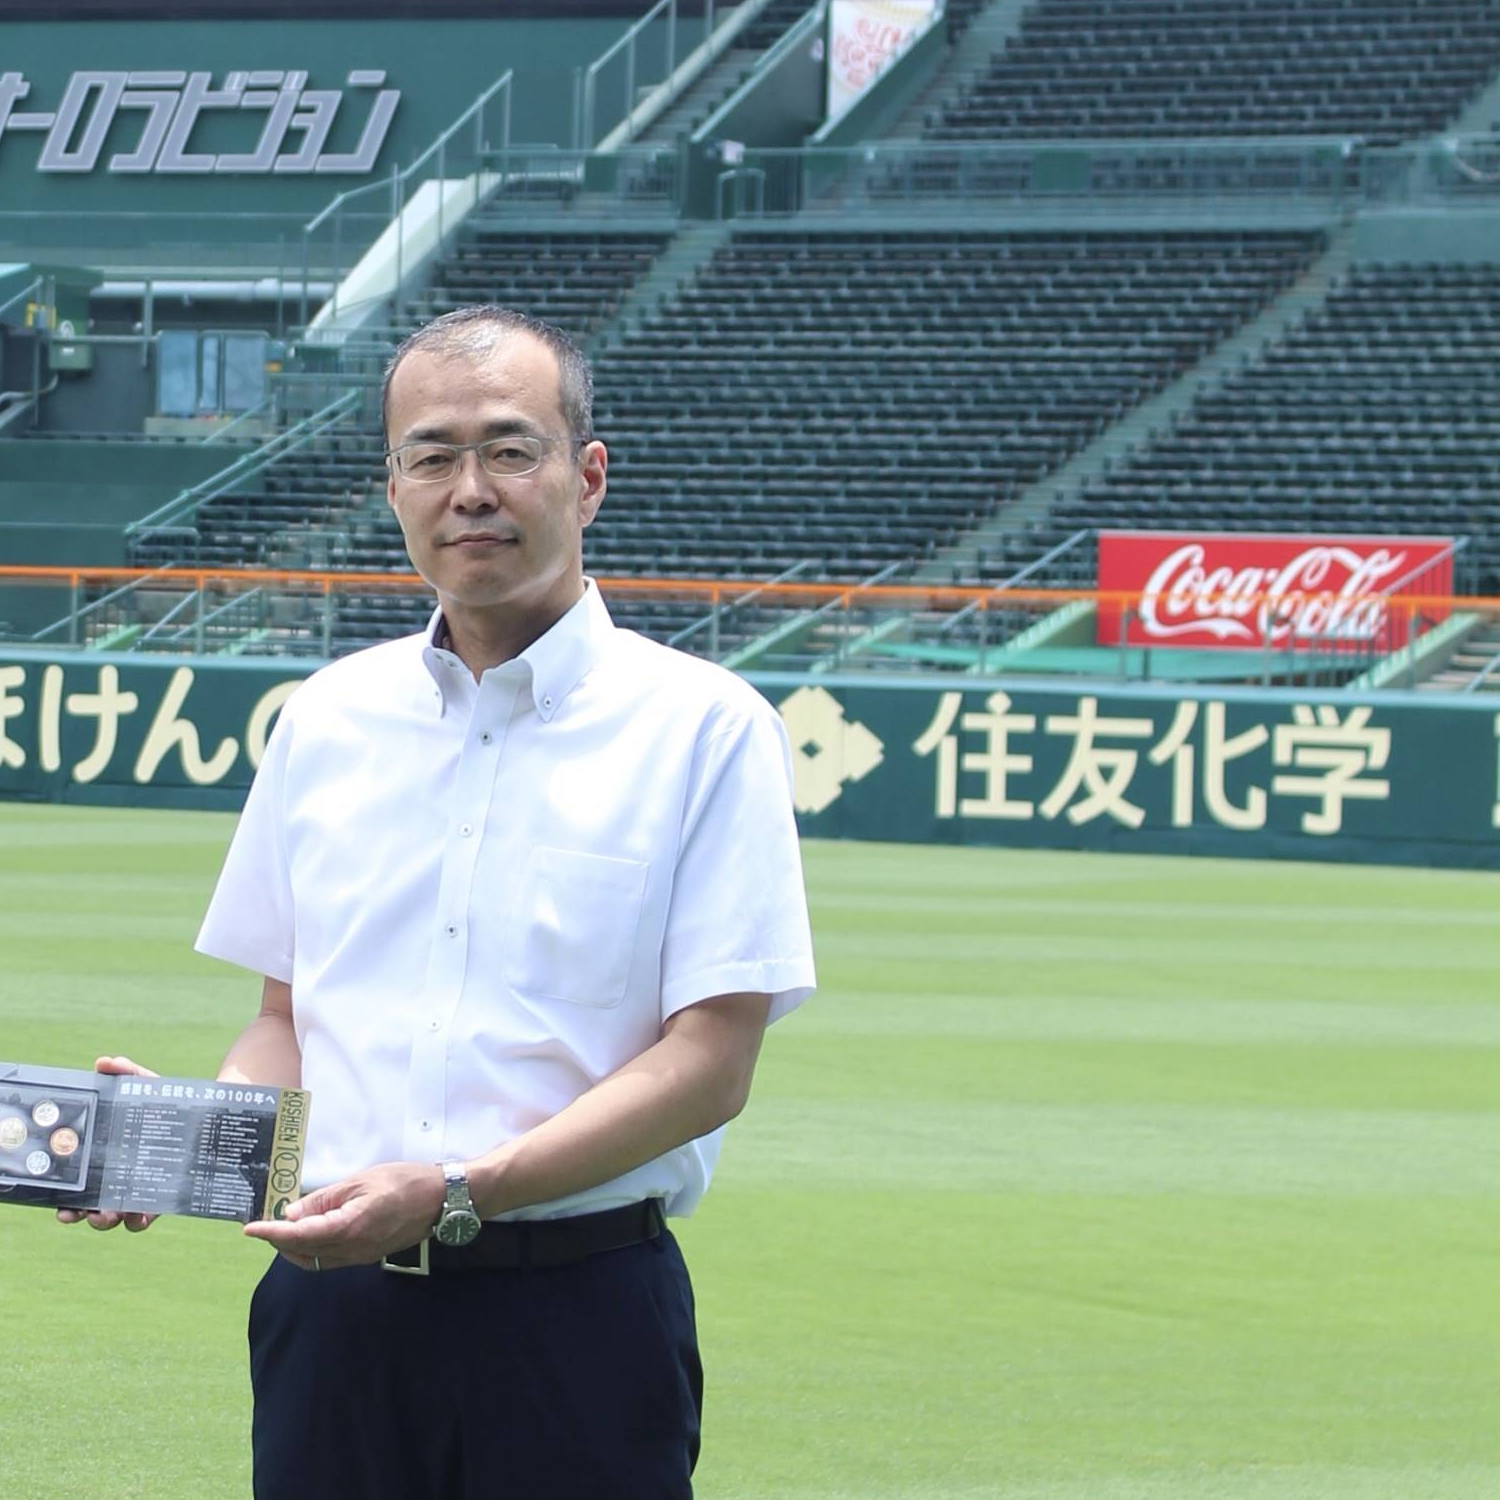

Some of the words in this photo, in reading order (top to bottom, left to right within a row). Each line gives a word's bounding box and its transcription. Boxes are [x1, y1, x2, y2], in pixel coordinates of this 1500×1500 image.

[1138, 544, 1408, 641] Coca-Cola
[912, 691, 1392, 837] 住友化学
[284, 1091, 305, 1143] KOSHIEN
